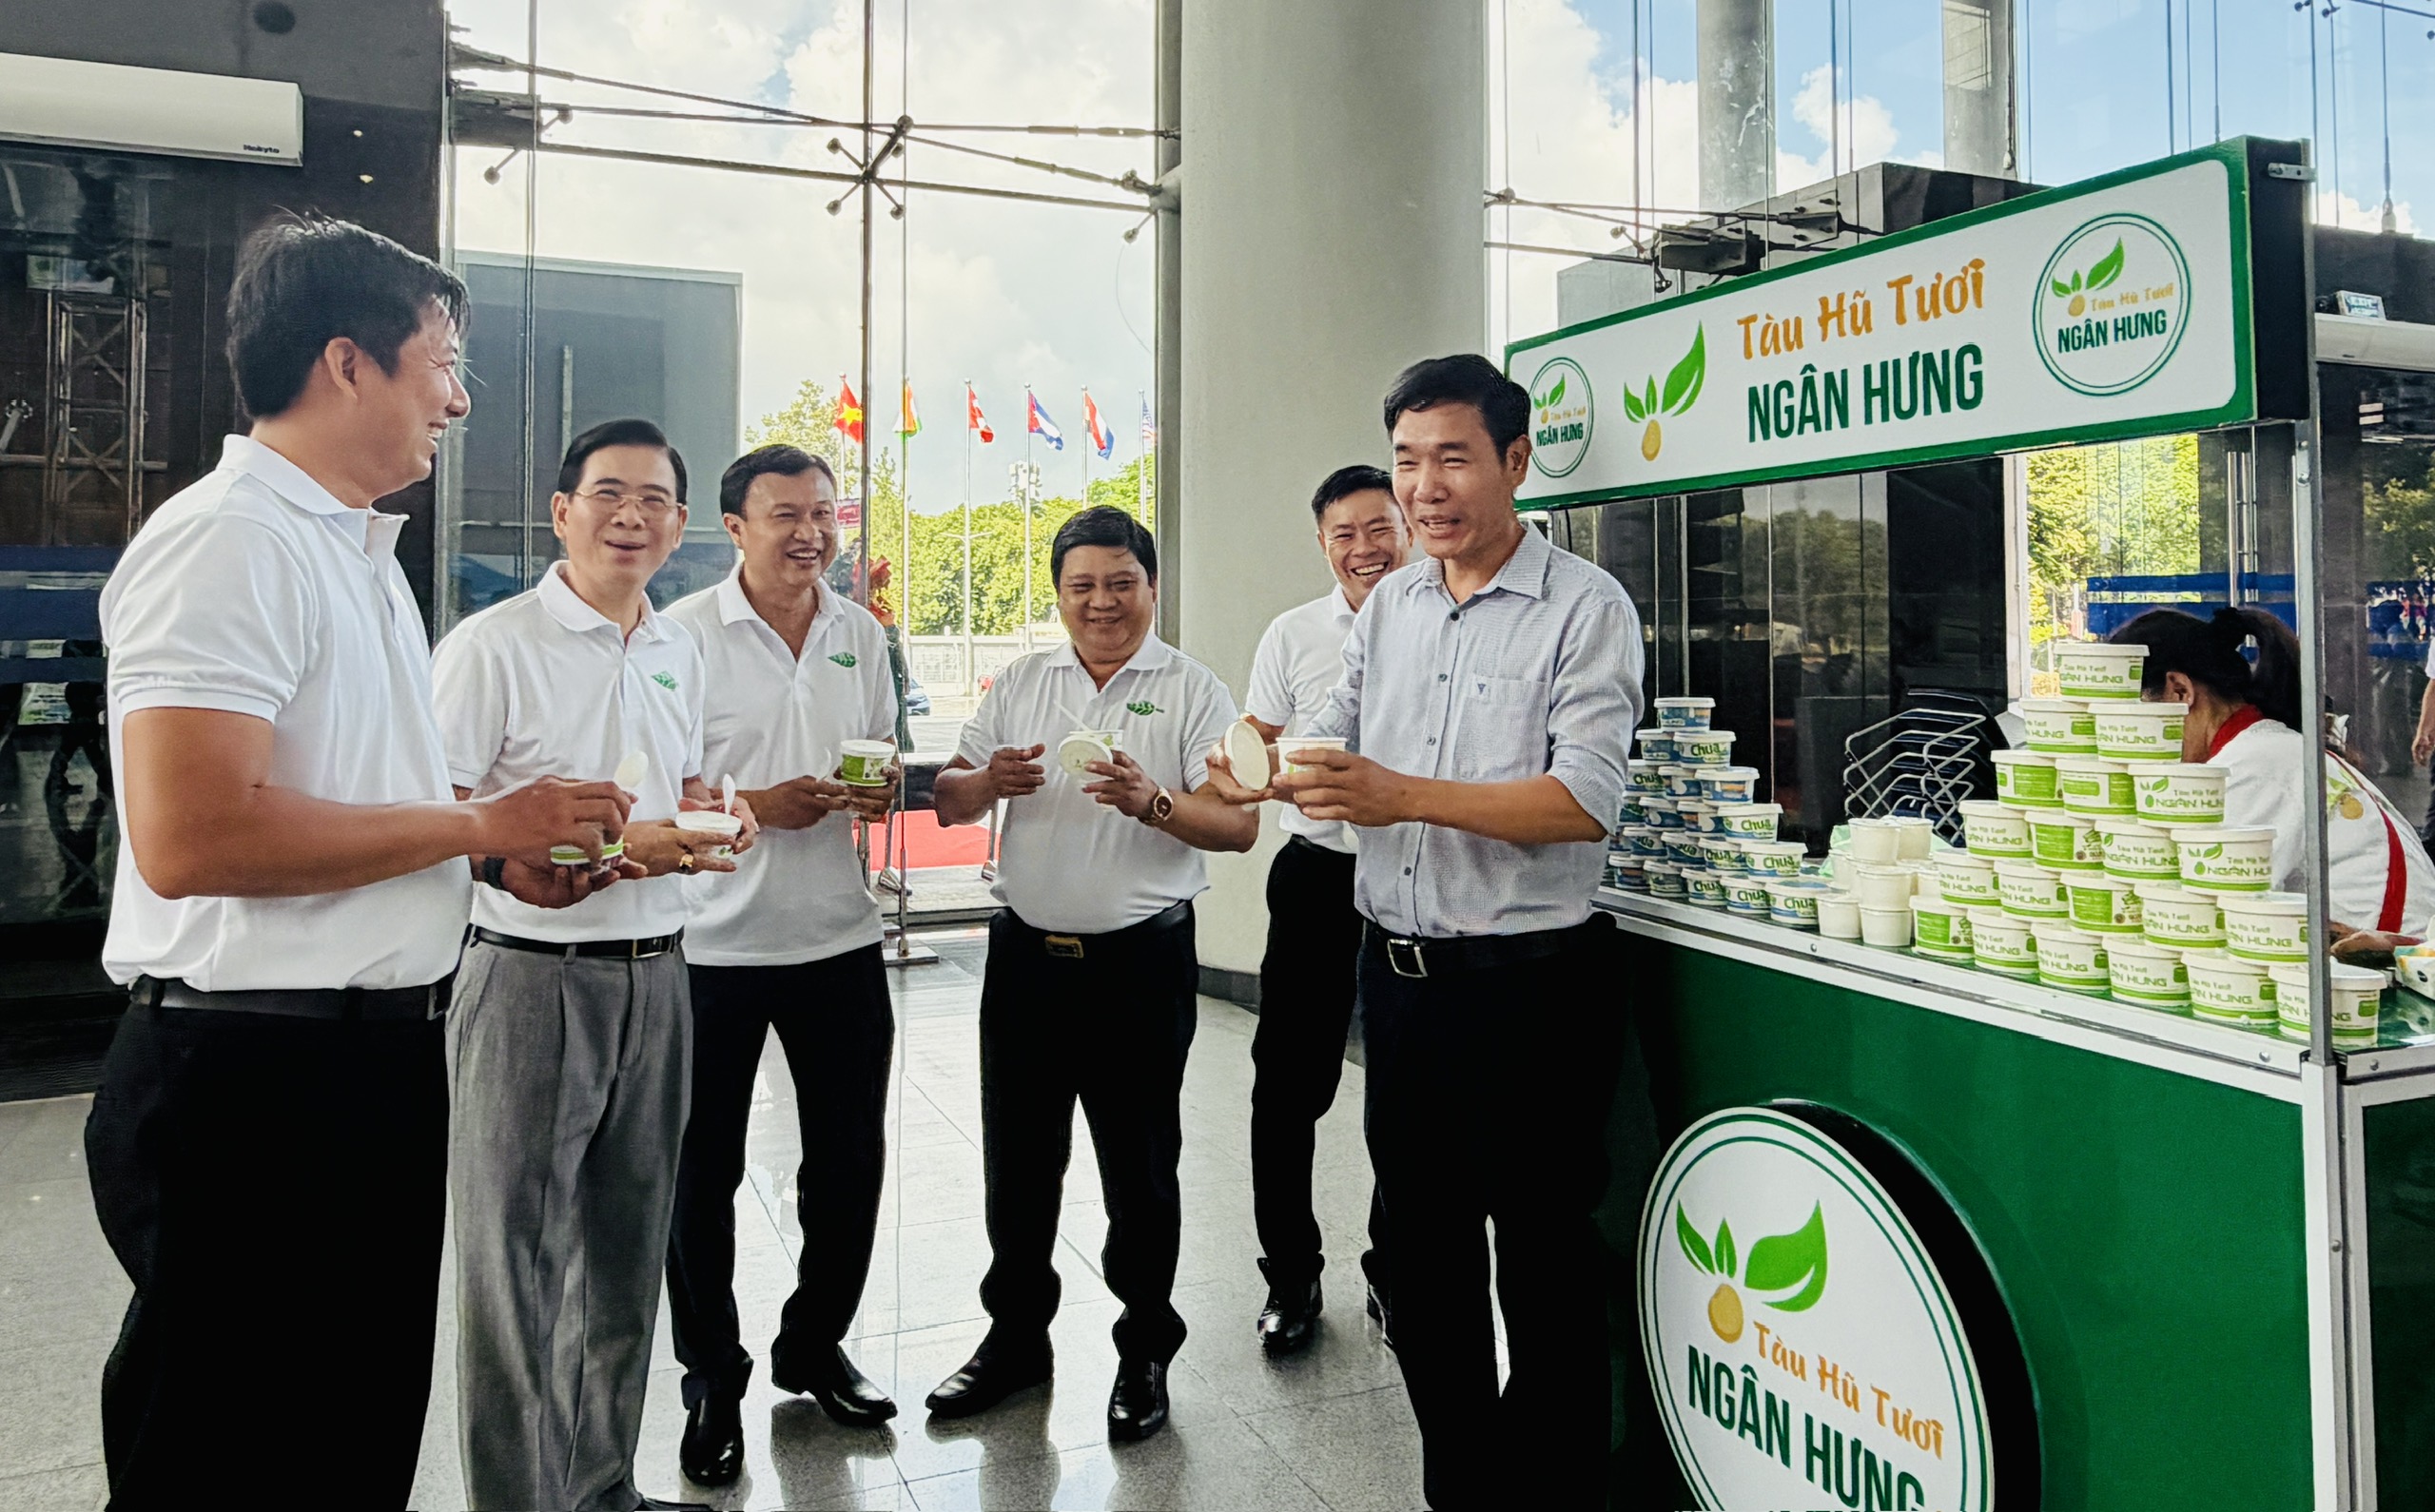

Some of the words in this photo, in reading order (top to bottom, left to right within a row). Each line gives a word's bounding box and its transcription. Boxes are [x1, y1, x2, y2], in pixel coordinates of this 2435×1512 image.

[1737, 313, 1803, 360] Tàu
[1818, 290, 1873, 342] Hũ
[1886, 258, 1985, 325] Tươi
[2057, 319, 2108, 354] NGÂN
[1748, 363, 1850, 443] NGÂN
[1863, 342, 1984, 425] HƯNG
[1687, 1344, 1791, 1470] NGÂN
[1753, 1320, 1807, 1382] Tàu
[1816, 1354, 1860, 1413] Hũ
[1870, 1383, 1944, 1461] Tươi
